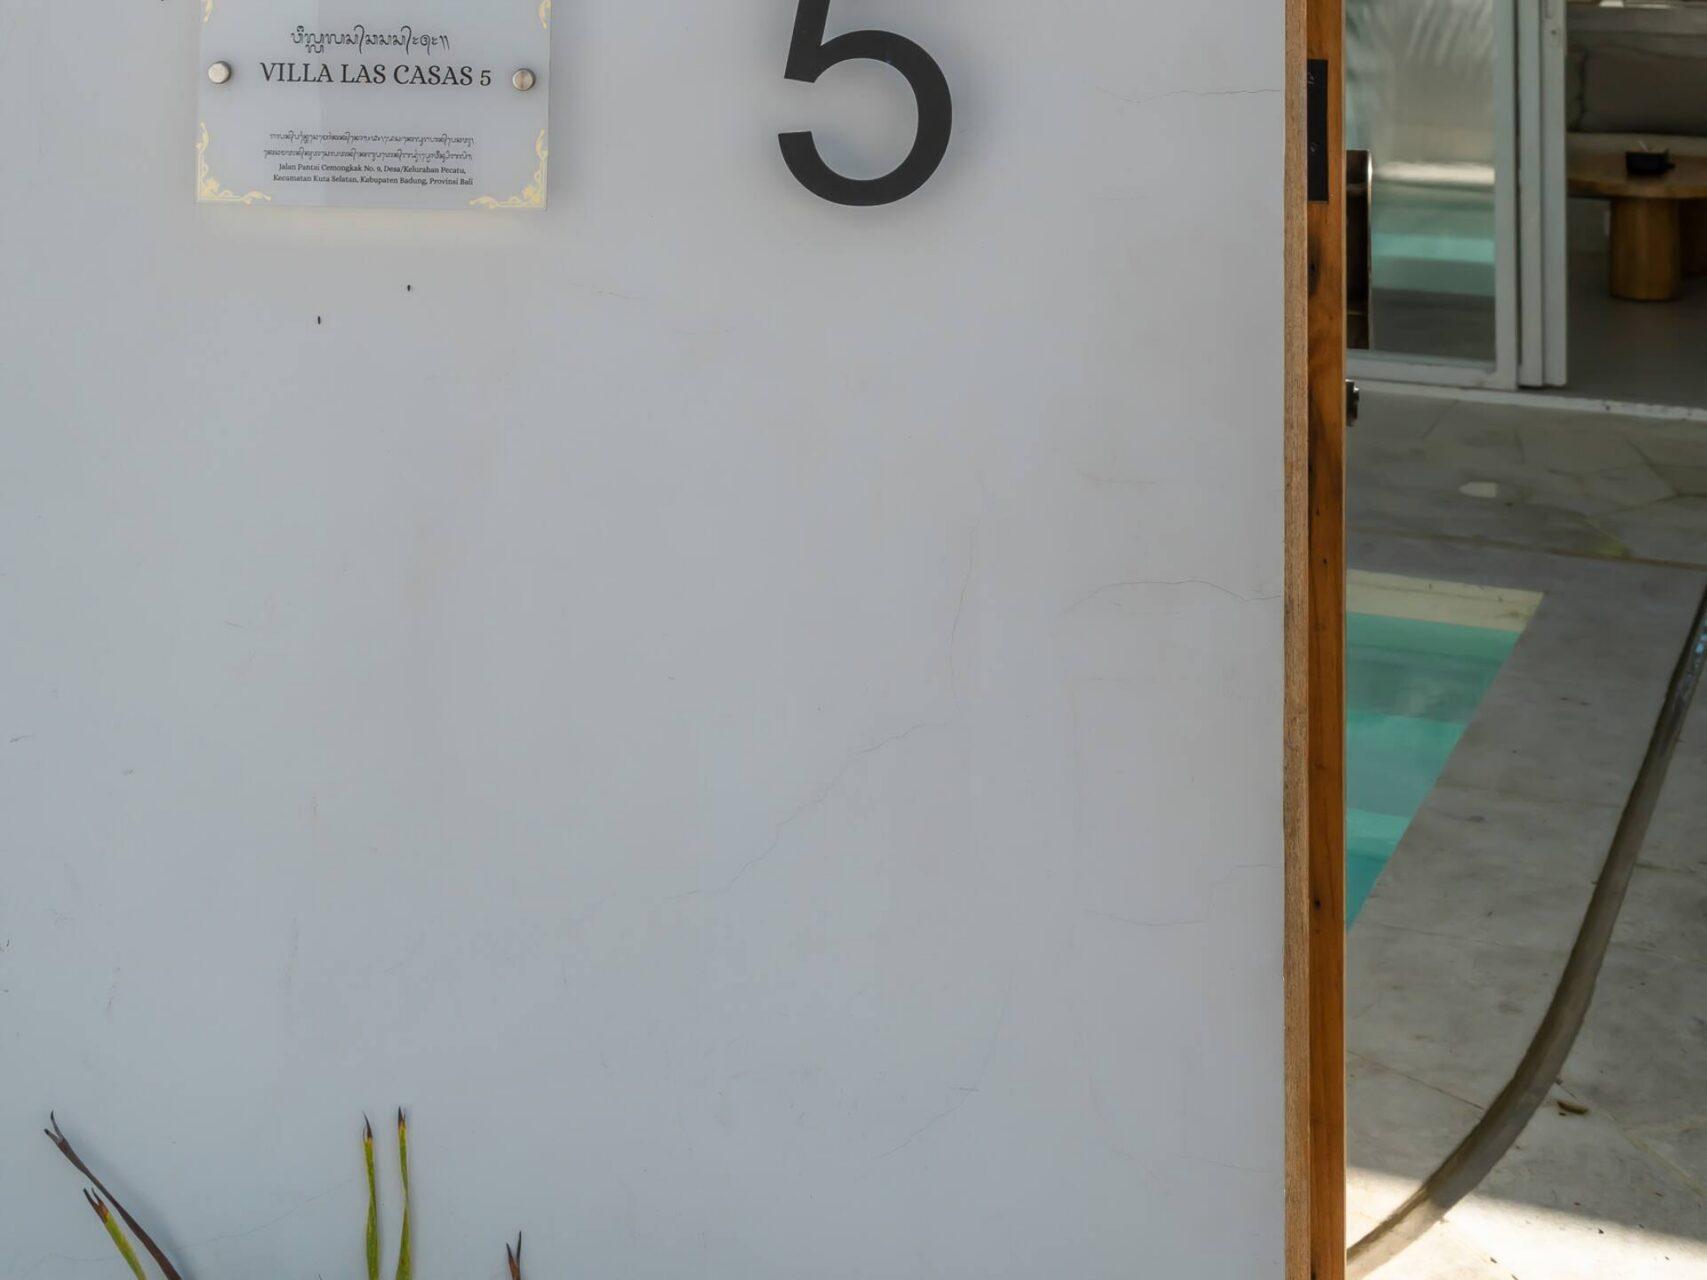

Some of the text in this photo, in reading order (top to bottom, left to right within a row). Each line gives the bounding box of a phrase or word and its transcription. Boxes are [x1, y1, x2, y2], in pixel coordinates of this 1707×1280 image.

[260, 63, 492, 87] VILLA LAS CASAS 5
[279, 163, 296, 171] Jalan
[321, 164, 362, 172] Cemongkak
[384, 165, 440, 174] Desa/Kelurahan
[273, 174, 312, 182] Kecamatan
[360, 176, 398, 185] Kabupaten
[400, 178, 428, 186] Badung,
[429, 178, 459, 186] Provinsi
